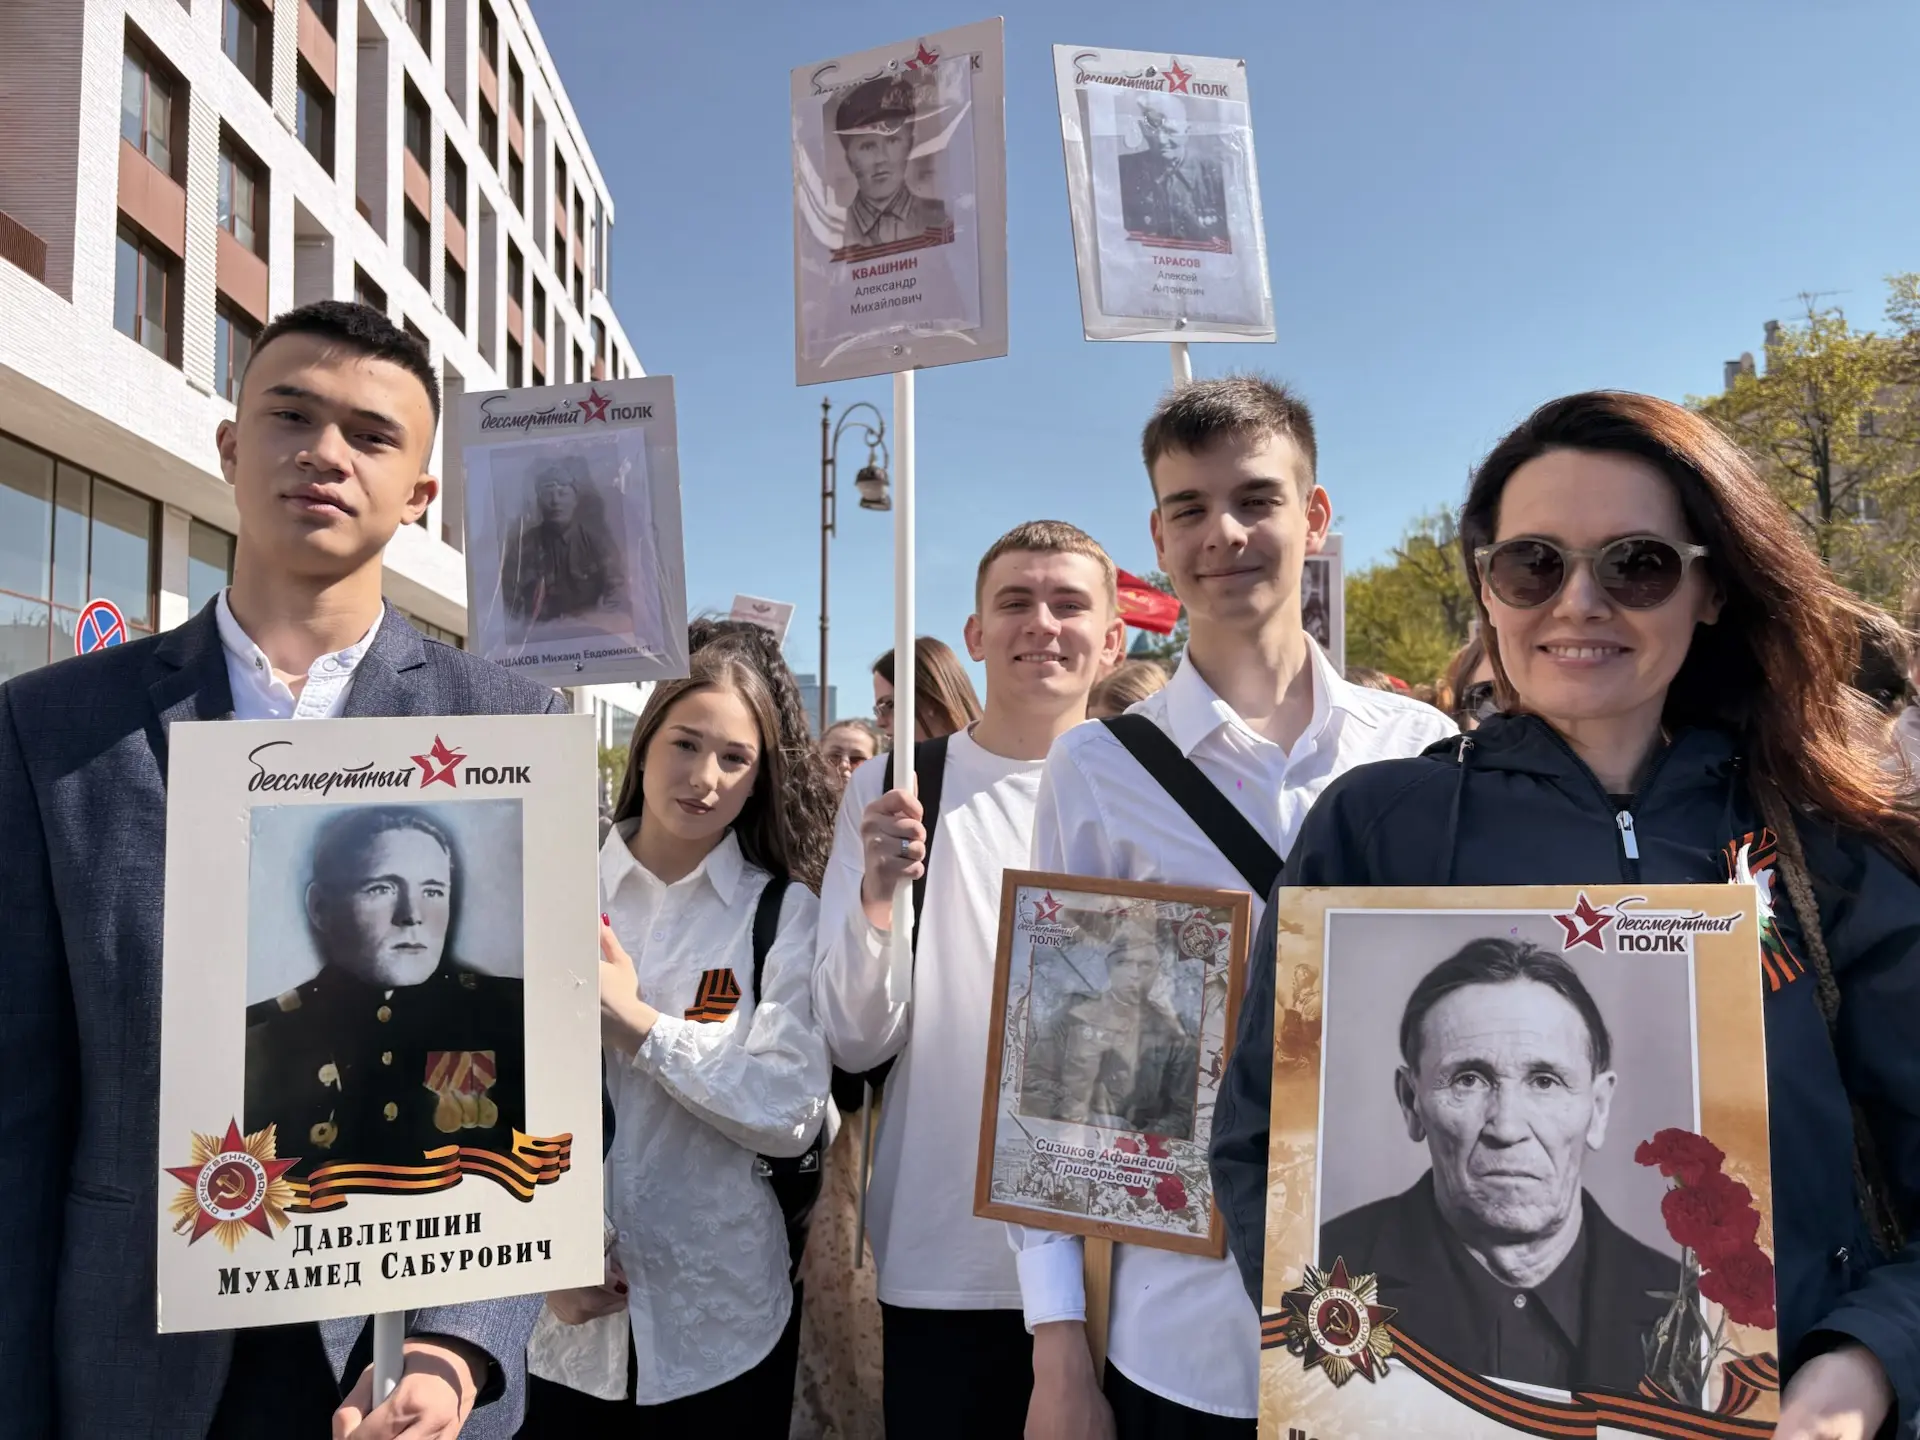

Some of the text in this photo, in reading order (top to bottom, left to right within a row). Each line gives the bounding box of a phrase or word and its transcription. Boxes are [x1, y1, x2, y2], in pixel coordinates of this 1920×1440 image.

[1192, 83, 1228, 96] ПОЛК
[851, 257, 918, 281] КВАШНИН
[1152, 255, 1201, 268] ТАРАСОВ
[854, 277, 917, 298] Александр
[849, 292, 922, 316] Михайлович
[611, 405, 652, 421] ПОЛК
[542, 650, 581, 664] Михаил
[465, 765, 532, 786] ПОЛК
[1029, 934, 1061, 947] ПОЛК
[1618, 935, 1686, 953] ПОЛК
[1035, 1137, 1176, 1172] Сизиков Афанасий
[1054, 1158, 1152, 1187] Григорьевич
[199, 1153, 261, 1216] ОТЕЧЕСТВЕННАЯ
[1308, 1290, 1364, 1347] ОТЕЧЕСТВЕННАЯ
